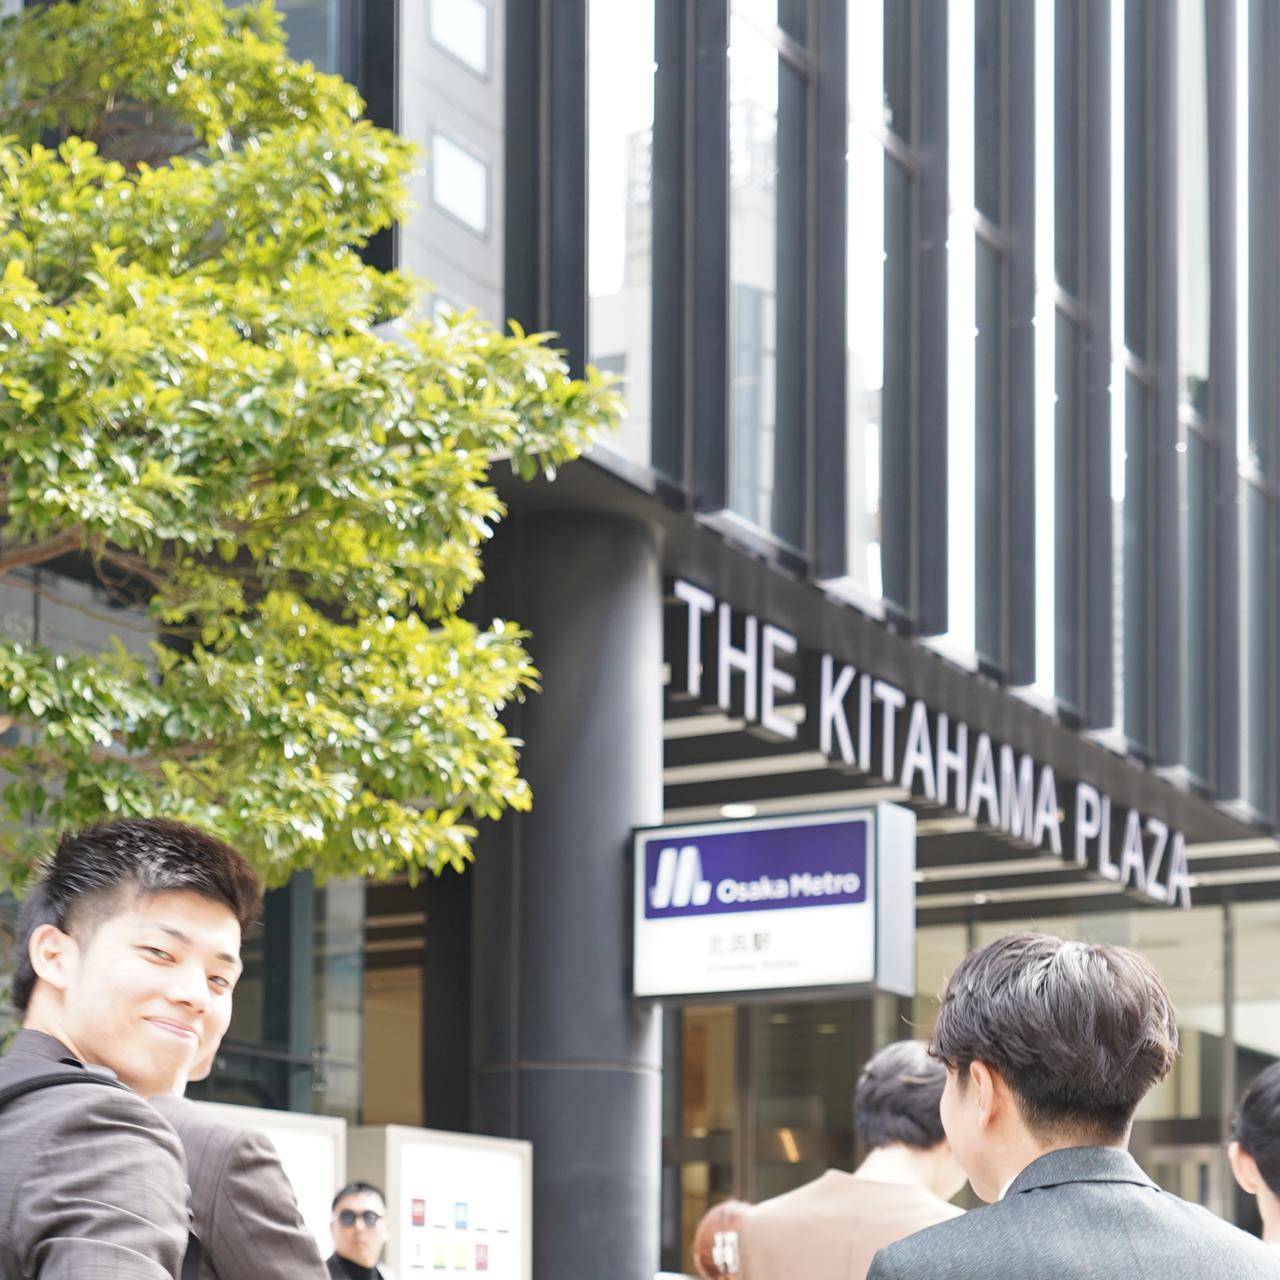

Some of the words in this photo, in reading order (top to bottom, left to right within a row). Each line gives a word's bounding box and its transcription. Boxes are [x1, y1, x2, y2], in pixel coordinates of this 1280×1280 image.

[674, 579, 797, 739] THE
[821, 653, 1062, 855] KITAHAMA
[1075, 782, 1191, 911] PLAZA
[716, 874, 789, 904] Osaka
[789, 870, 860, 898] Metro
